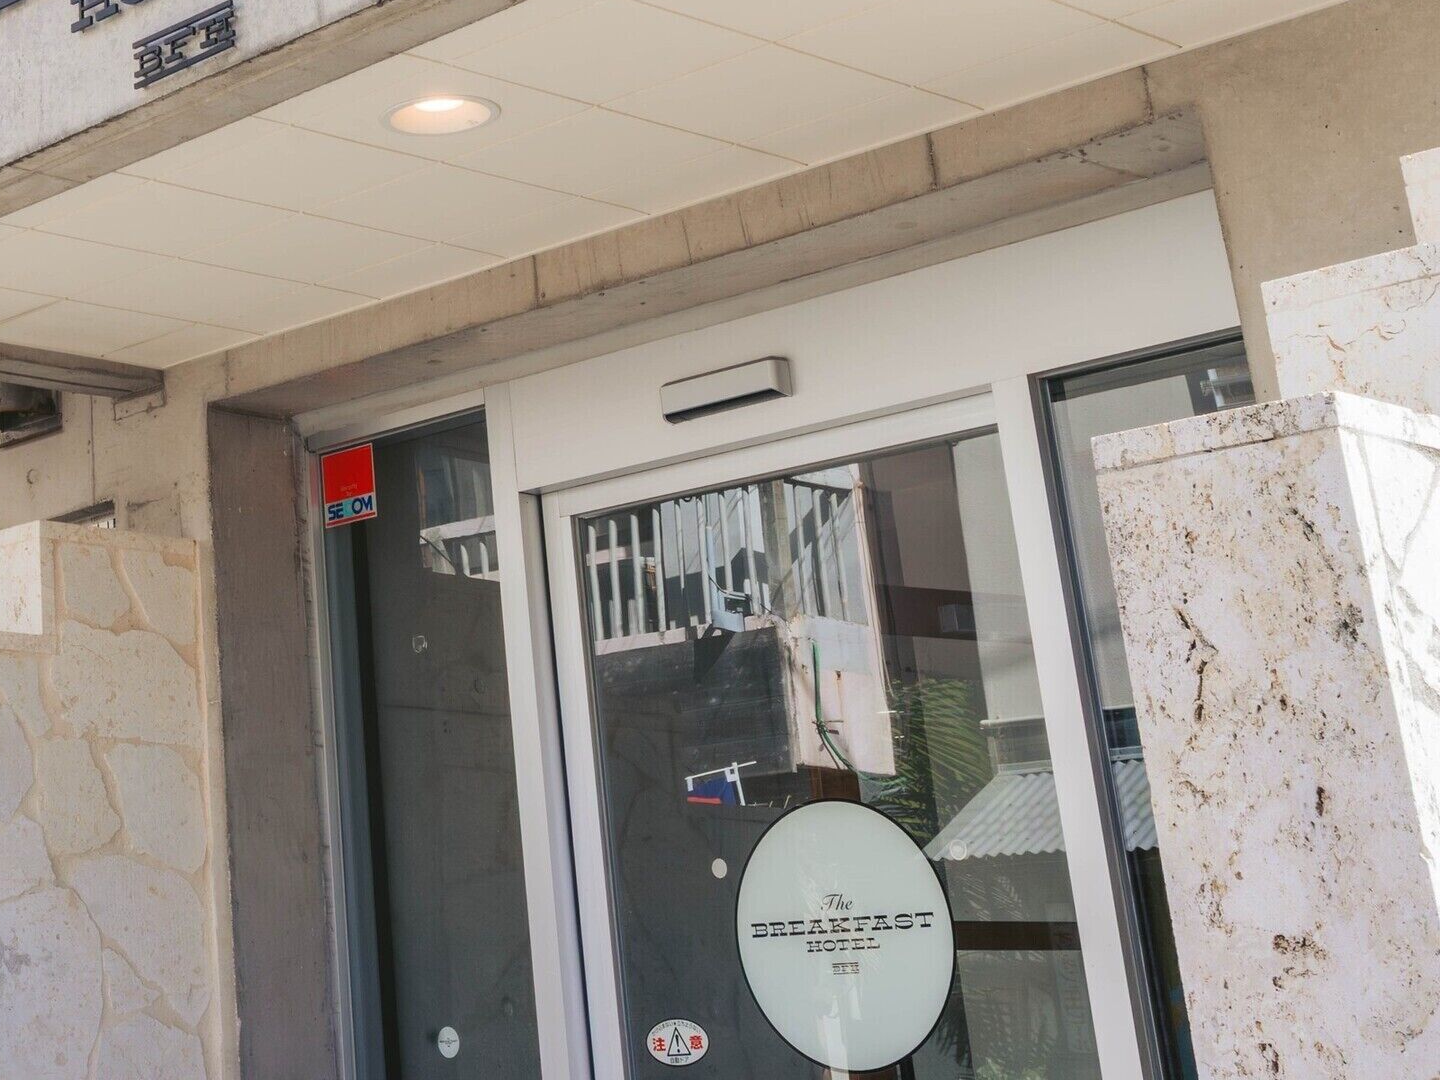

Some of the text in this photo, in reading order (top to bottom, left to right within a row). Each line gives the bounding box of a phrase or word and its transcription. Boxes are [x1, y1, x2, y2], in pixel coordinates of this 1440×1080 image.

[132, 4, 237, 82] BFH
[328, 495, 373, 521] SECOM
[820, 893, 853, 911] The
[750, 911, 935, 938] BREAKFAST
[806, 937, 881, 953] HOTEL
